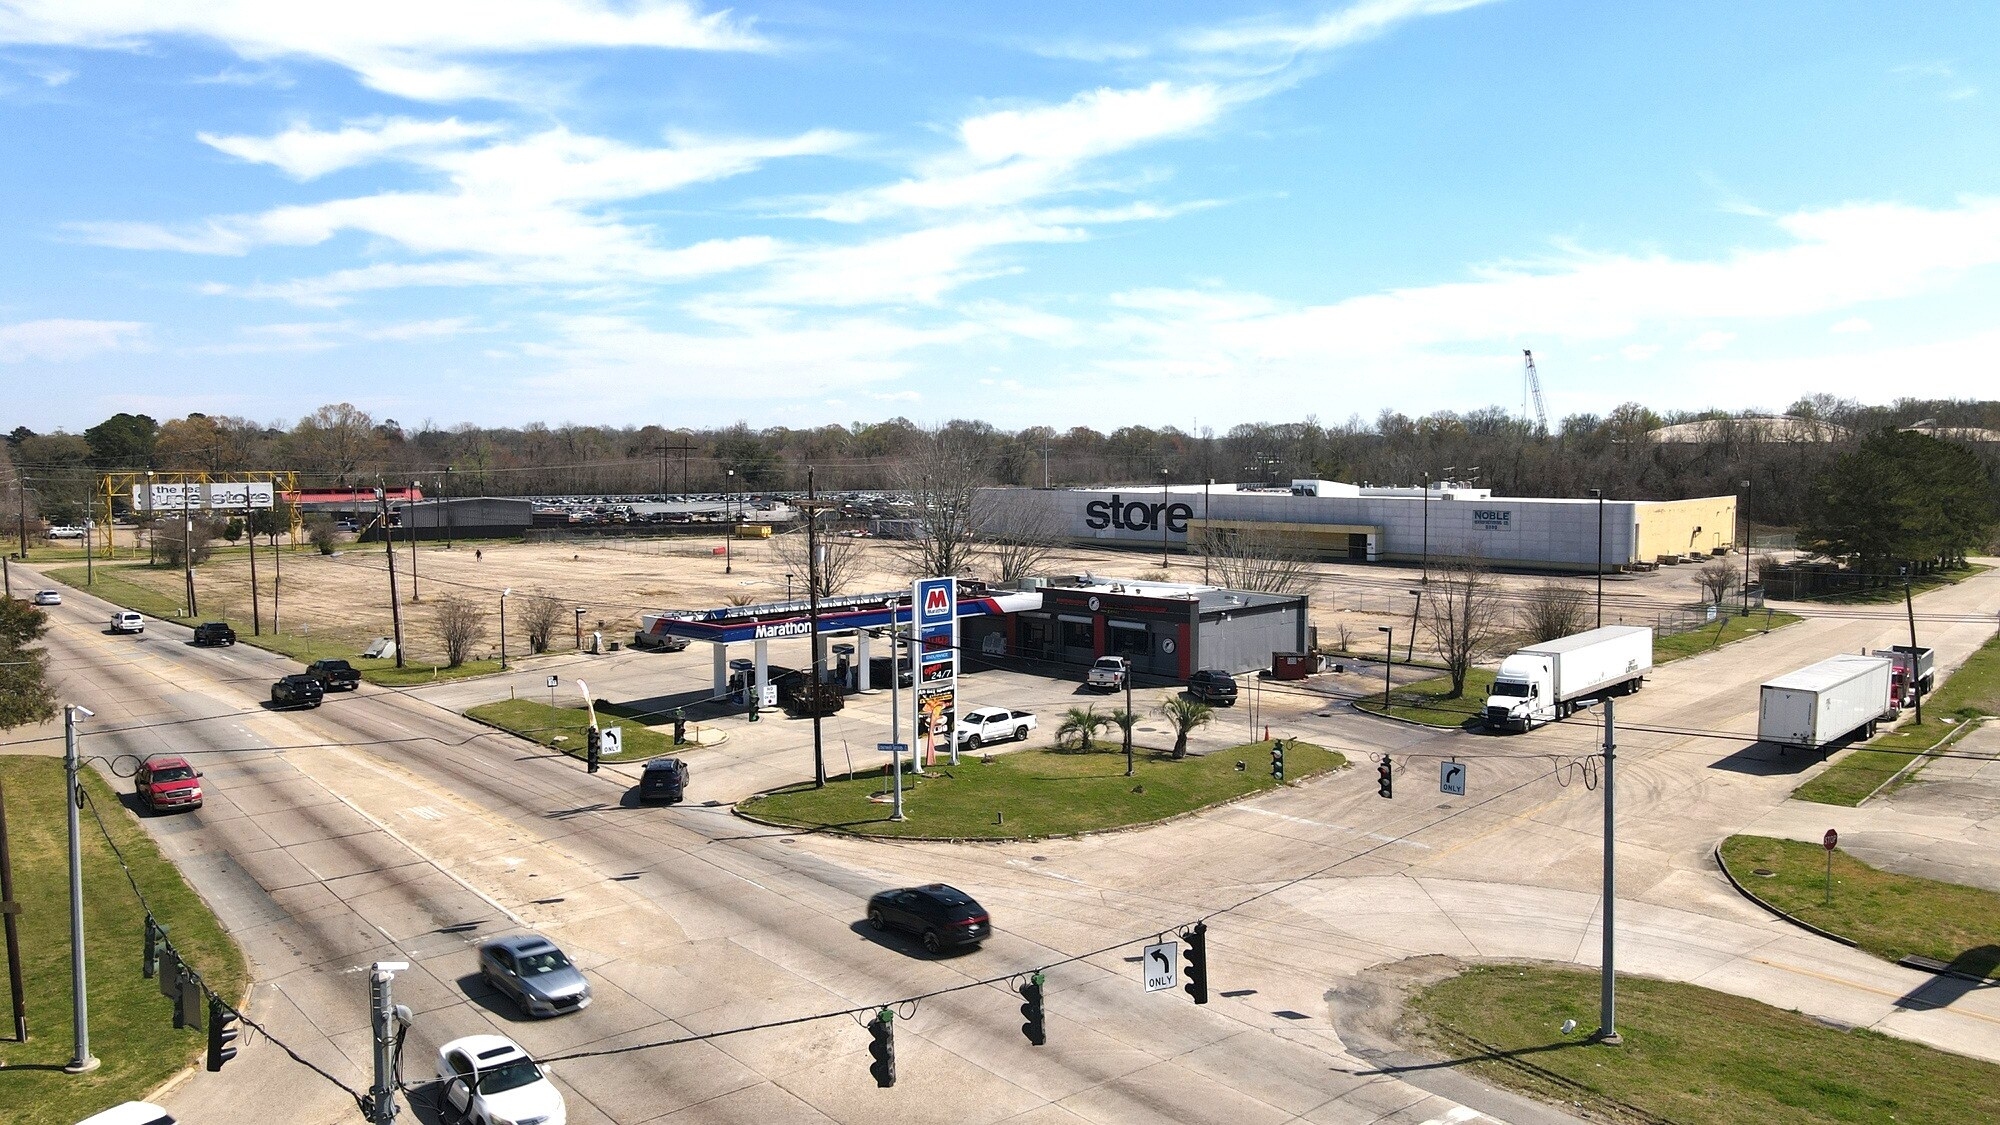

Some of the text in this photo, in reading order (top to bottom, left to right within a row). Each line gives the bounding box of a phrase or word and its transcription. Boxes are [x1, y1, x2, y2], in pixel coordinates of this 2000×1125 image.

[156, 486, 177, 494] the
[1086, 494, 1193, 533] store
[1474, 511, 1509, 520] NOBLE
[927, 590, 947, 609] M
[755, 621, 812, 638] Marathon
[931, 669, 951, 680] 24/7
[1443, 784, 1461, 792] ONLY
[1149, 975, 1172, 987] ONLY
